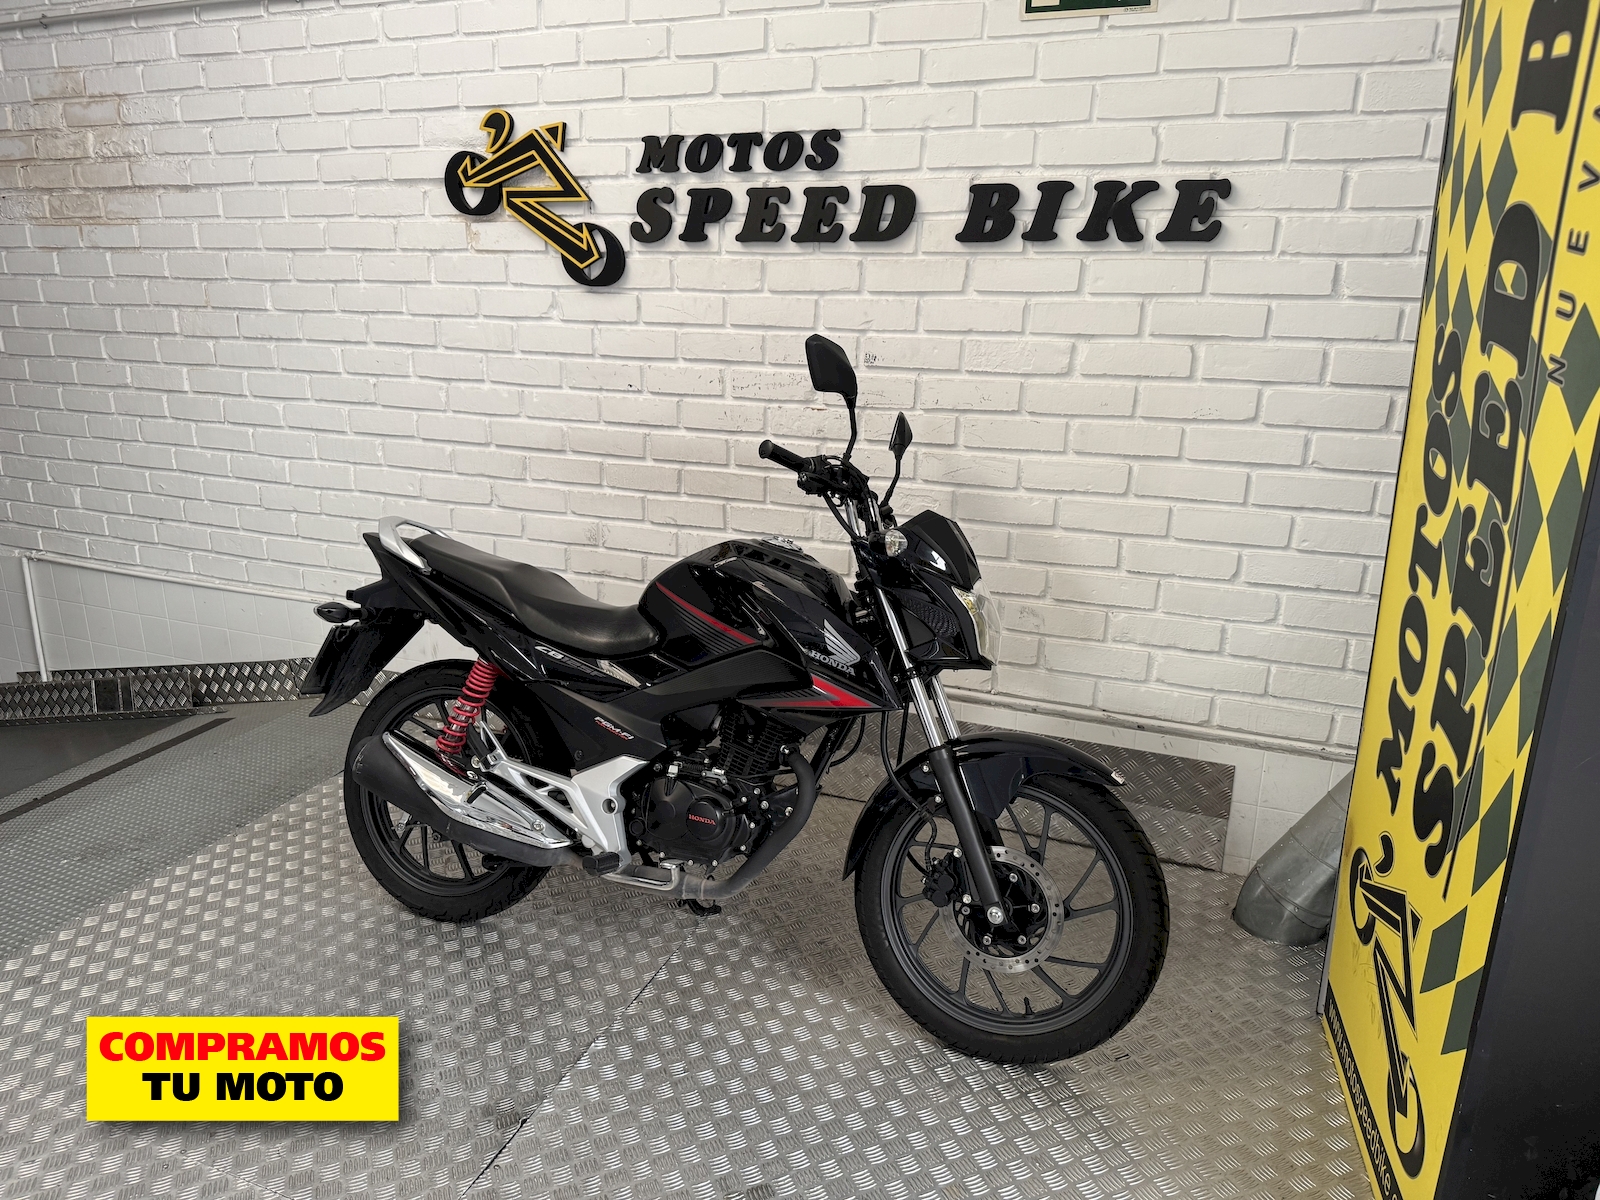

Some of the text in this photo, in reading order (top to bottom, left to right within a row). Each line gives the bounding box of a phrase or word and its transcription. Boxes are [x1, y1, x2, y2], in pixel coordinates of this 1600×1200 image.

[635, 128, 842, 174] MOTOS
[629, 179, 1232, 244] SPEED BIKE
[1546, 104, 1600, 388] NUEV
[1376, 322, 1463, 817] MOTOS
[1412, 201, 1542, 878] SPEED
[808, 649, 856, 678] HONDA
[688, 813, 717, 826] HONDA
